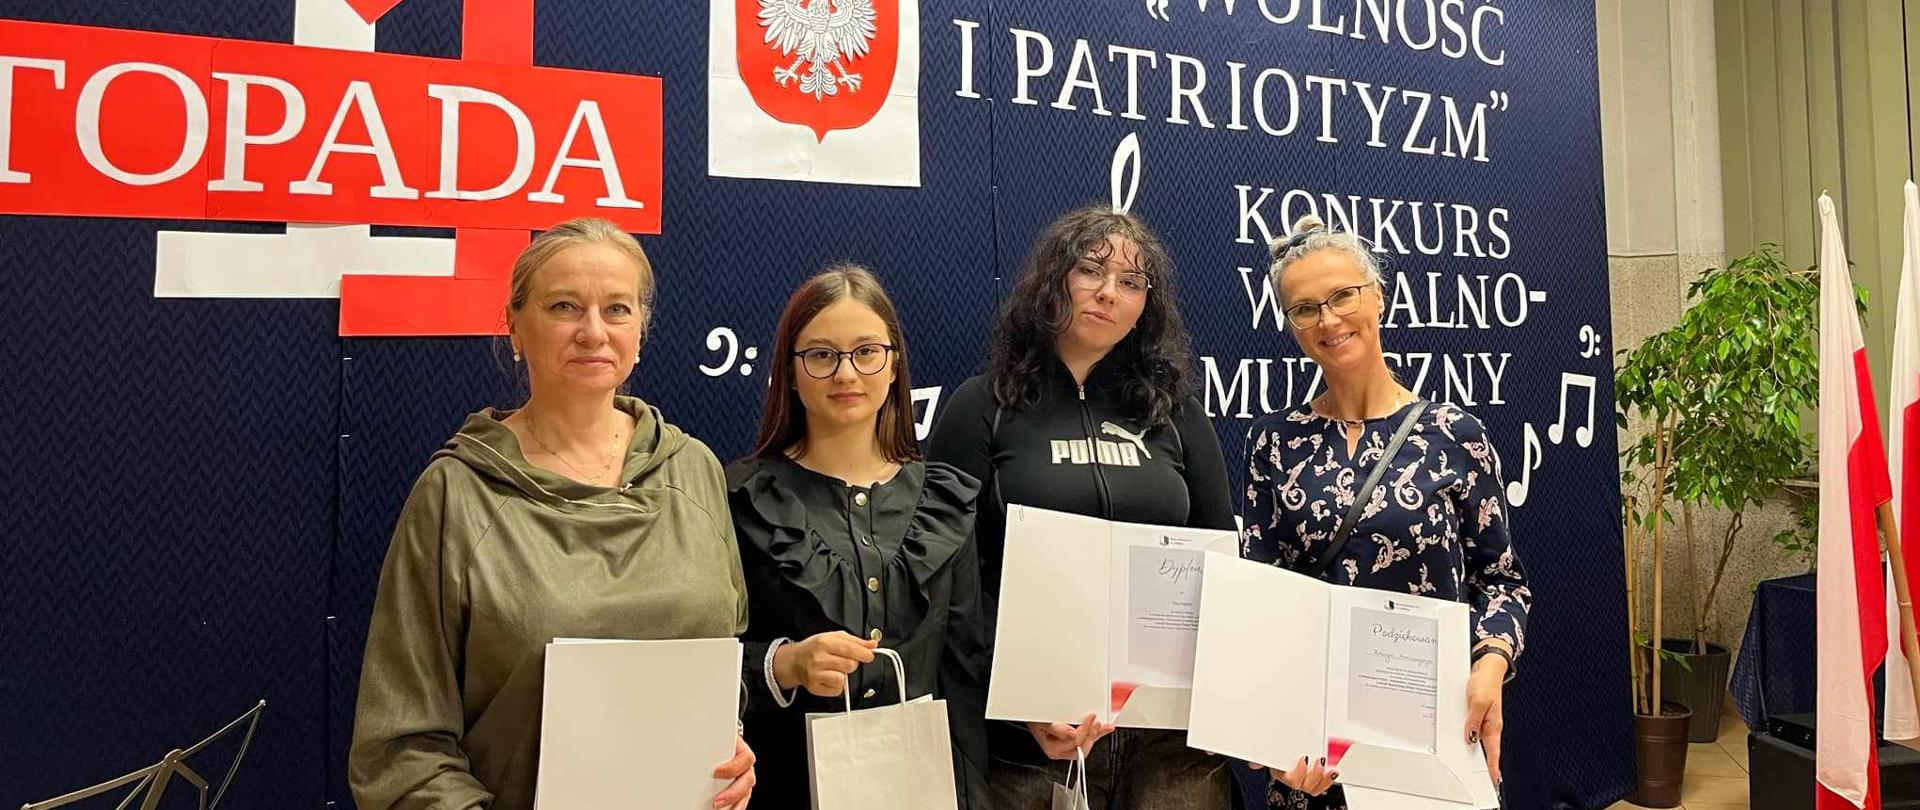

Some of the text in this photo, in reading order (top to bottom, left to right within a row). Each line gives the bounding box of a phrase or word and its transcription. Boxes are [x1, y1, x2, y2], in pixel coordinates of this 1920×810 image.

[953, 19, 981, 99] I
[1234, 184, 1510, 259] KONKURS
[1237, 267, 1547, 332] WALNO-
[1050, 437, 1140, 466] PUMA
